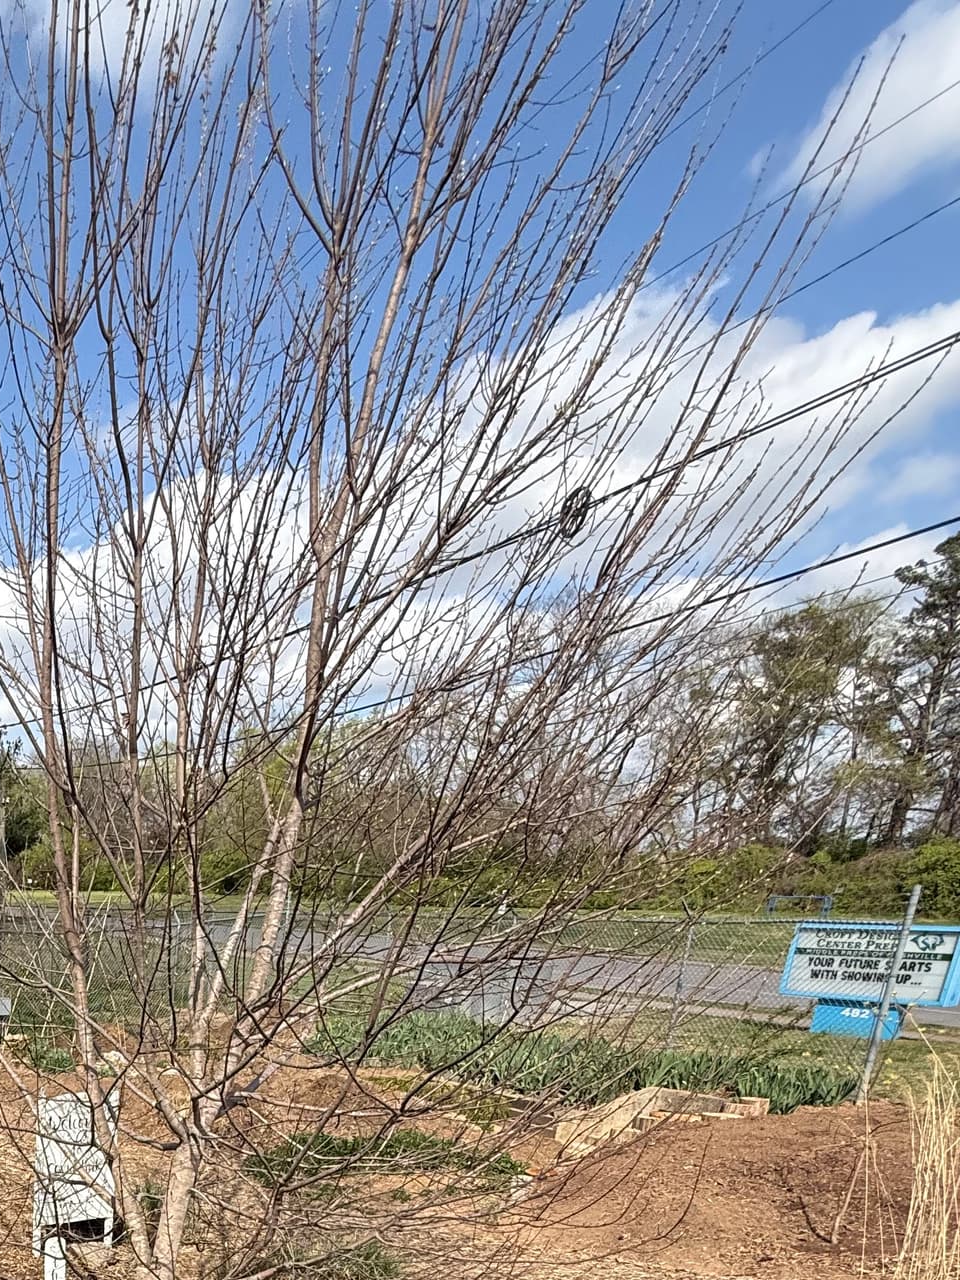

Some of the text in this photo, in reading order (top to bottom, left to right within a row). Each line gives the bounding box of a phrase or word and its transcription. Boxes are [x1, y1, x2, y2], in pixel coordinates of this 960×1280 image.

[816, 938, 863, 949] CENTER
[808, 956, 933, 972] YOUR FUTURE SARTS
[810, 969, 838, 980] WITH
